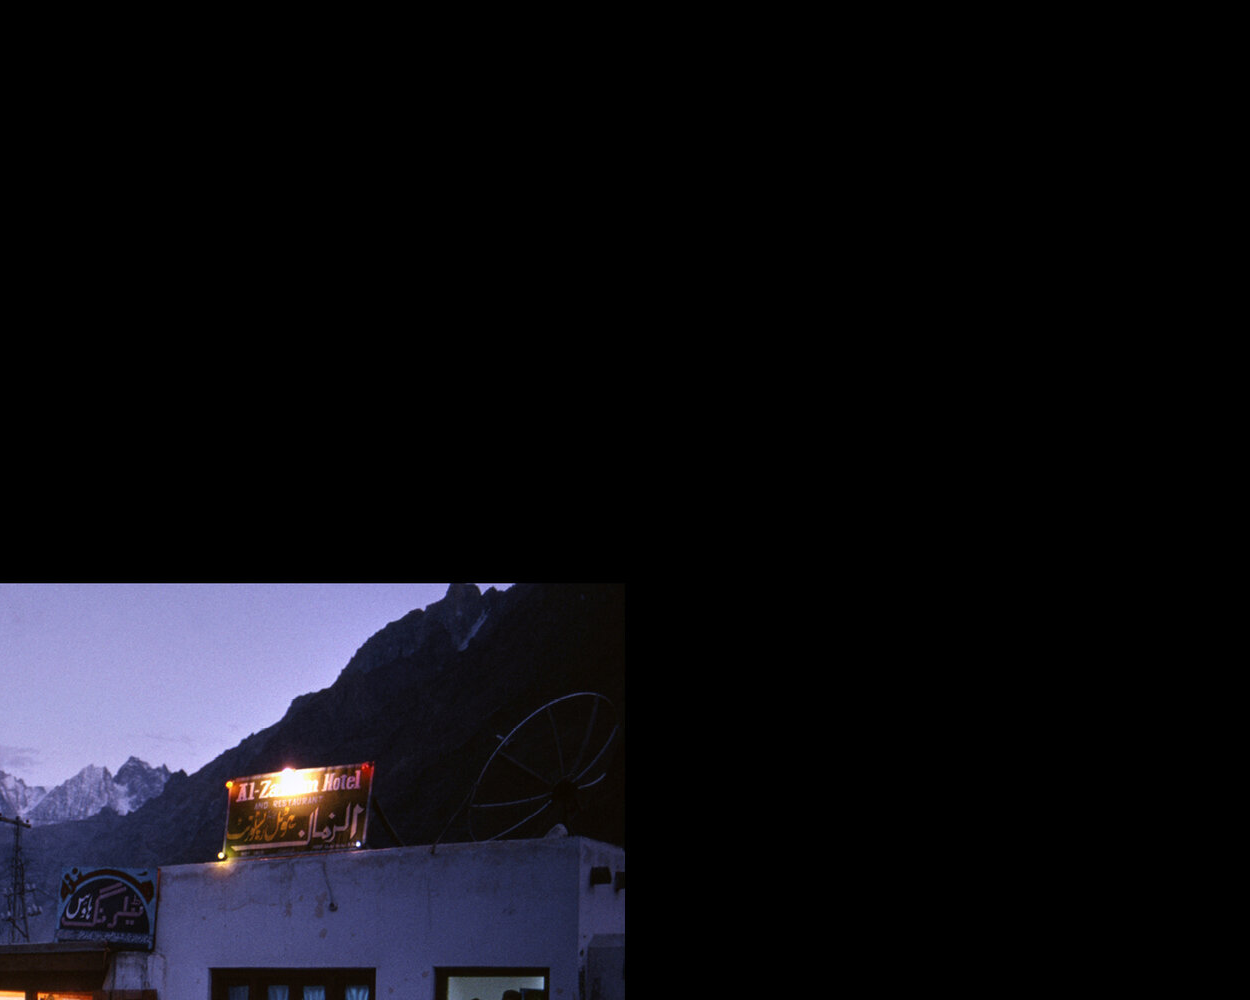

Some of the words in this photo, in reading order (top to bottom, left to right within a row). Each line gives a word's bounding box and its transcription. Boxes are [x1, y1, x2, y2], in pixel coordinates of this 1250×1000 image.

[236, 779, 319, 802] Al-Zan
[322, 769, 361, 792] Hotel
[254, 801, 269, 810] AND
[273, 796, 324, 809] RESTAURANT
